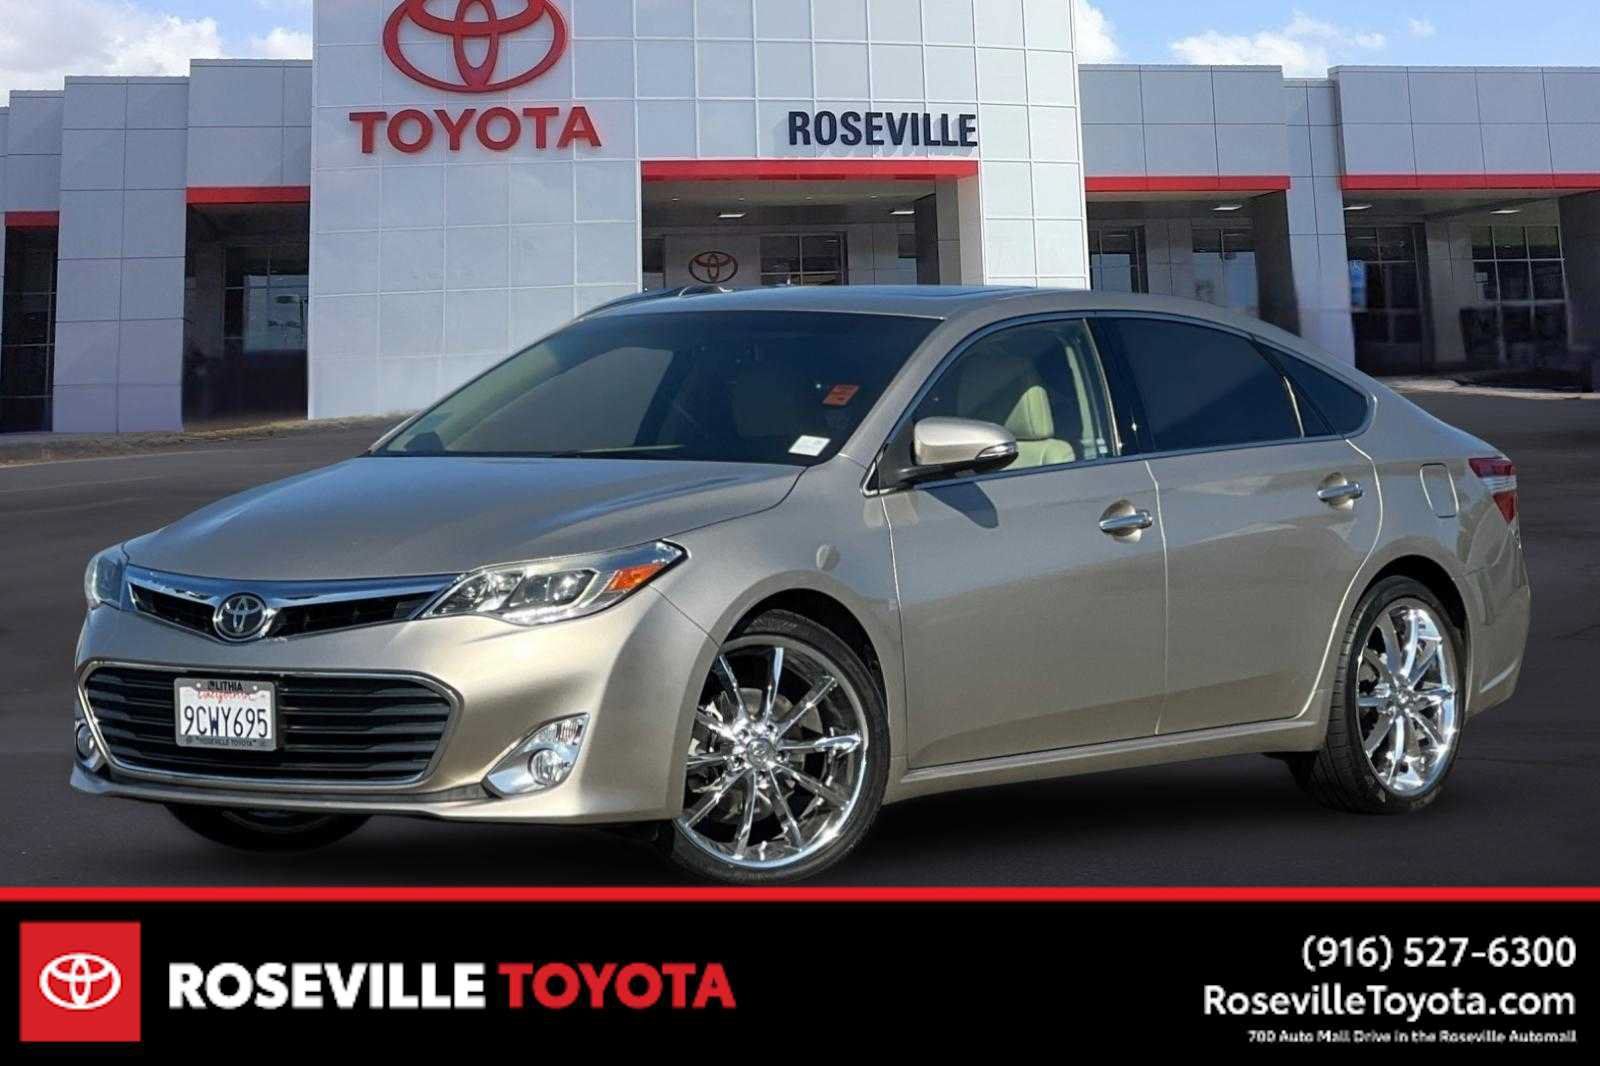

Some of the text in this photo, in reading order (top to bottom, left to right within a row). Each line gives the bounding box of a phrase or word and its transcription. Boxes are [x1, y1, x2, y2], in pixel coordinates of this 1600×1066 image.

[350, 105, 602, 153] TOYOTA
[789, 110, 978, 147] ROSEVILLE
[215, 681, 243, 691] LITHIA
[184, 705, 268, 738] 9CWY695
